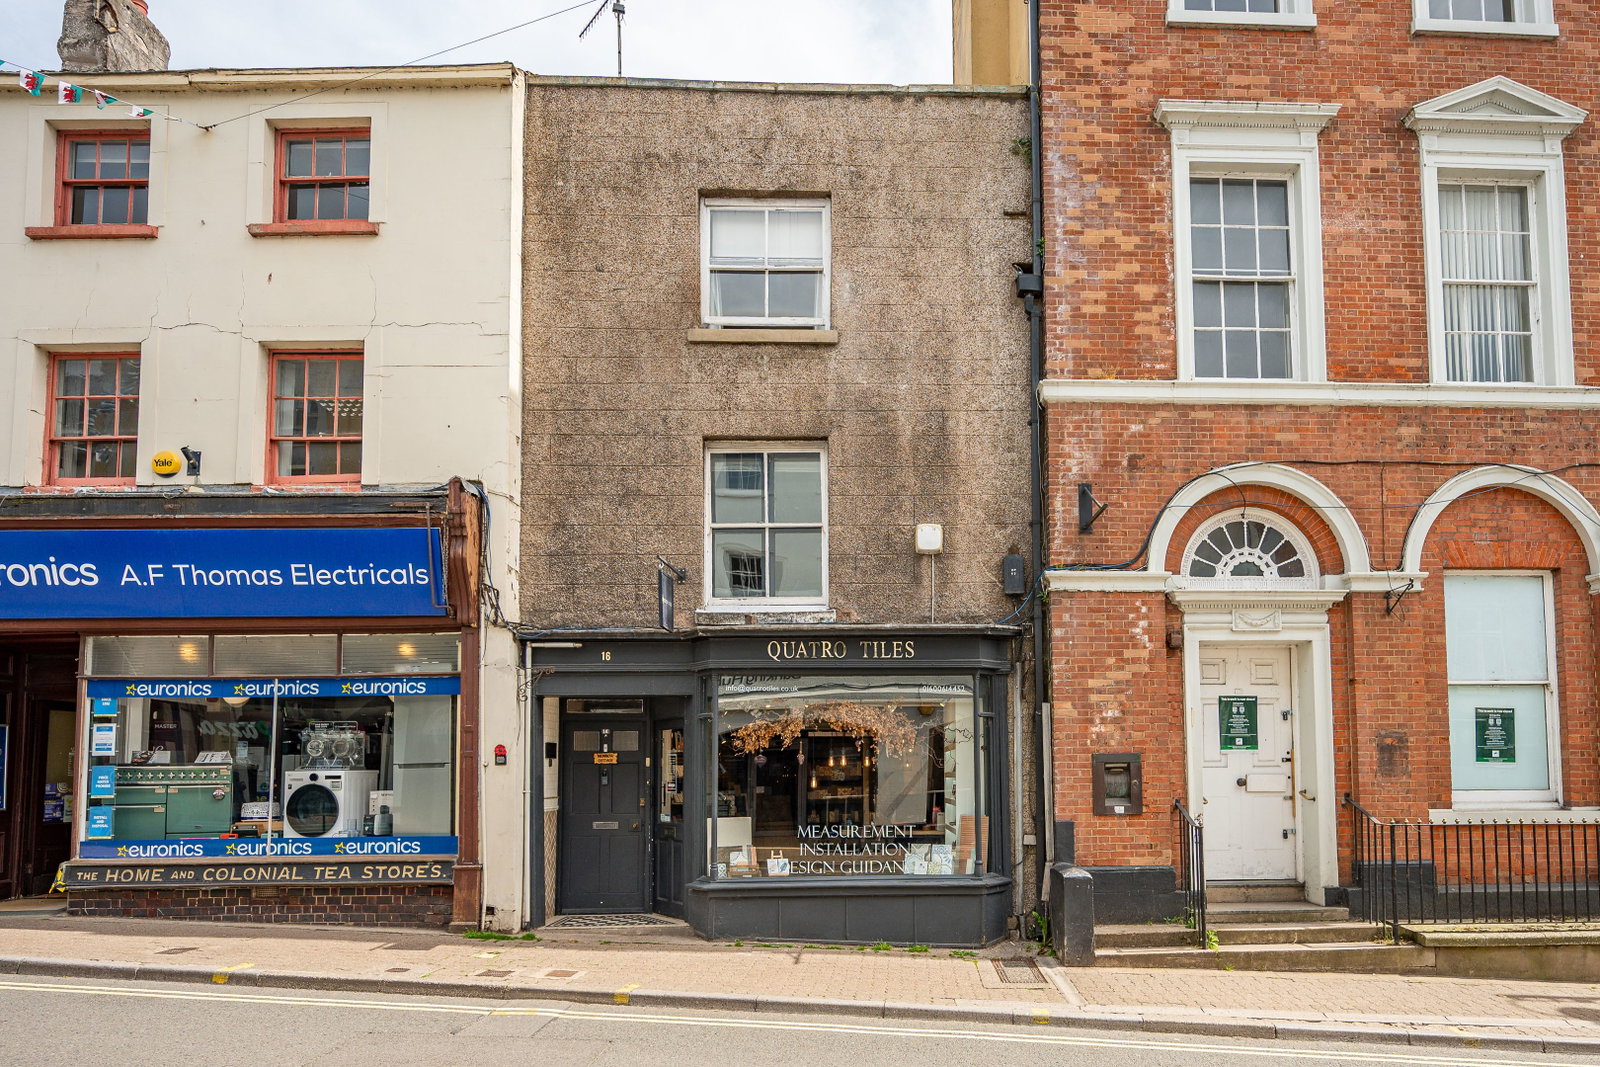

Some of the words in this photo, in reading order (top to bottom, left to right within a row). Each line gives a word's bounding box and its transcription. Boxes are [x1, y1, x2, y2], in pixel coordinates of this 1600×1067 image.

[120, 564, 164, 586] A.F
[172, 564, 283, 586] Thomas
[290, 563, 429, 586] Electricals
[601, 651, 611, 661] 16
[767, 640, 847, 662] QUATRO
[859, 640, 915, 658] TILES
[136, 680, 212, 696] euronics
[244, 680, 320, 696] euronics
[352, 679, 426, 694] euronics
[797, 824, 917, 840] MEASUREMENT
[128, 841, 204, 858] euronics
[237, 839, 312, 856] euronics
[346, 838, 421, 854] euronics
[800, 842, 912, 858] INSTALLATION
[76, 872, 98, 881] THE
[105, 868, 165, 882] HOME
[170, 870, 195, 880] AND
[203, 865, 303, 881] COLONIAL
[313, 866, 351, 880] TEA
[361, 864, 447, 879] STORES.
[787, 860, 836, 876] ESIGN
[840, 860, 907, 876] GUIDAN
